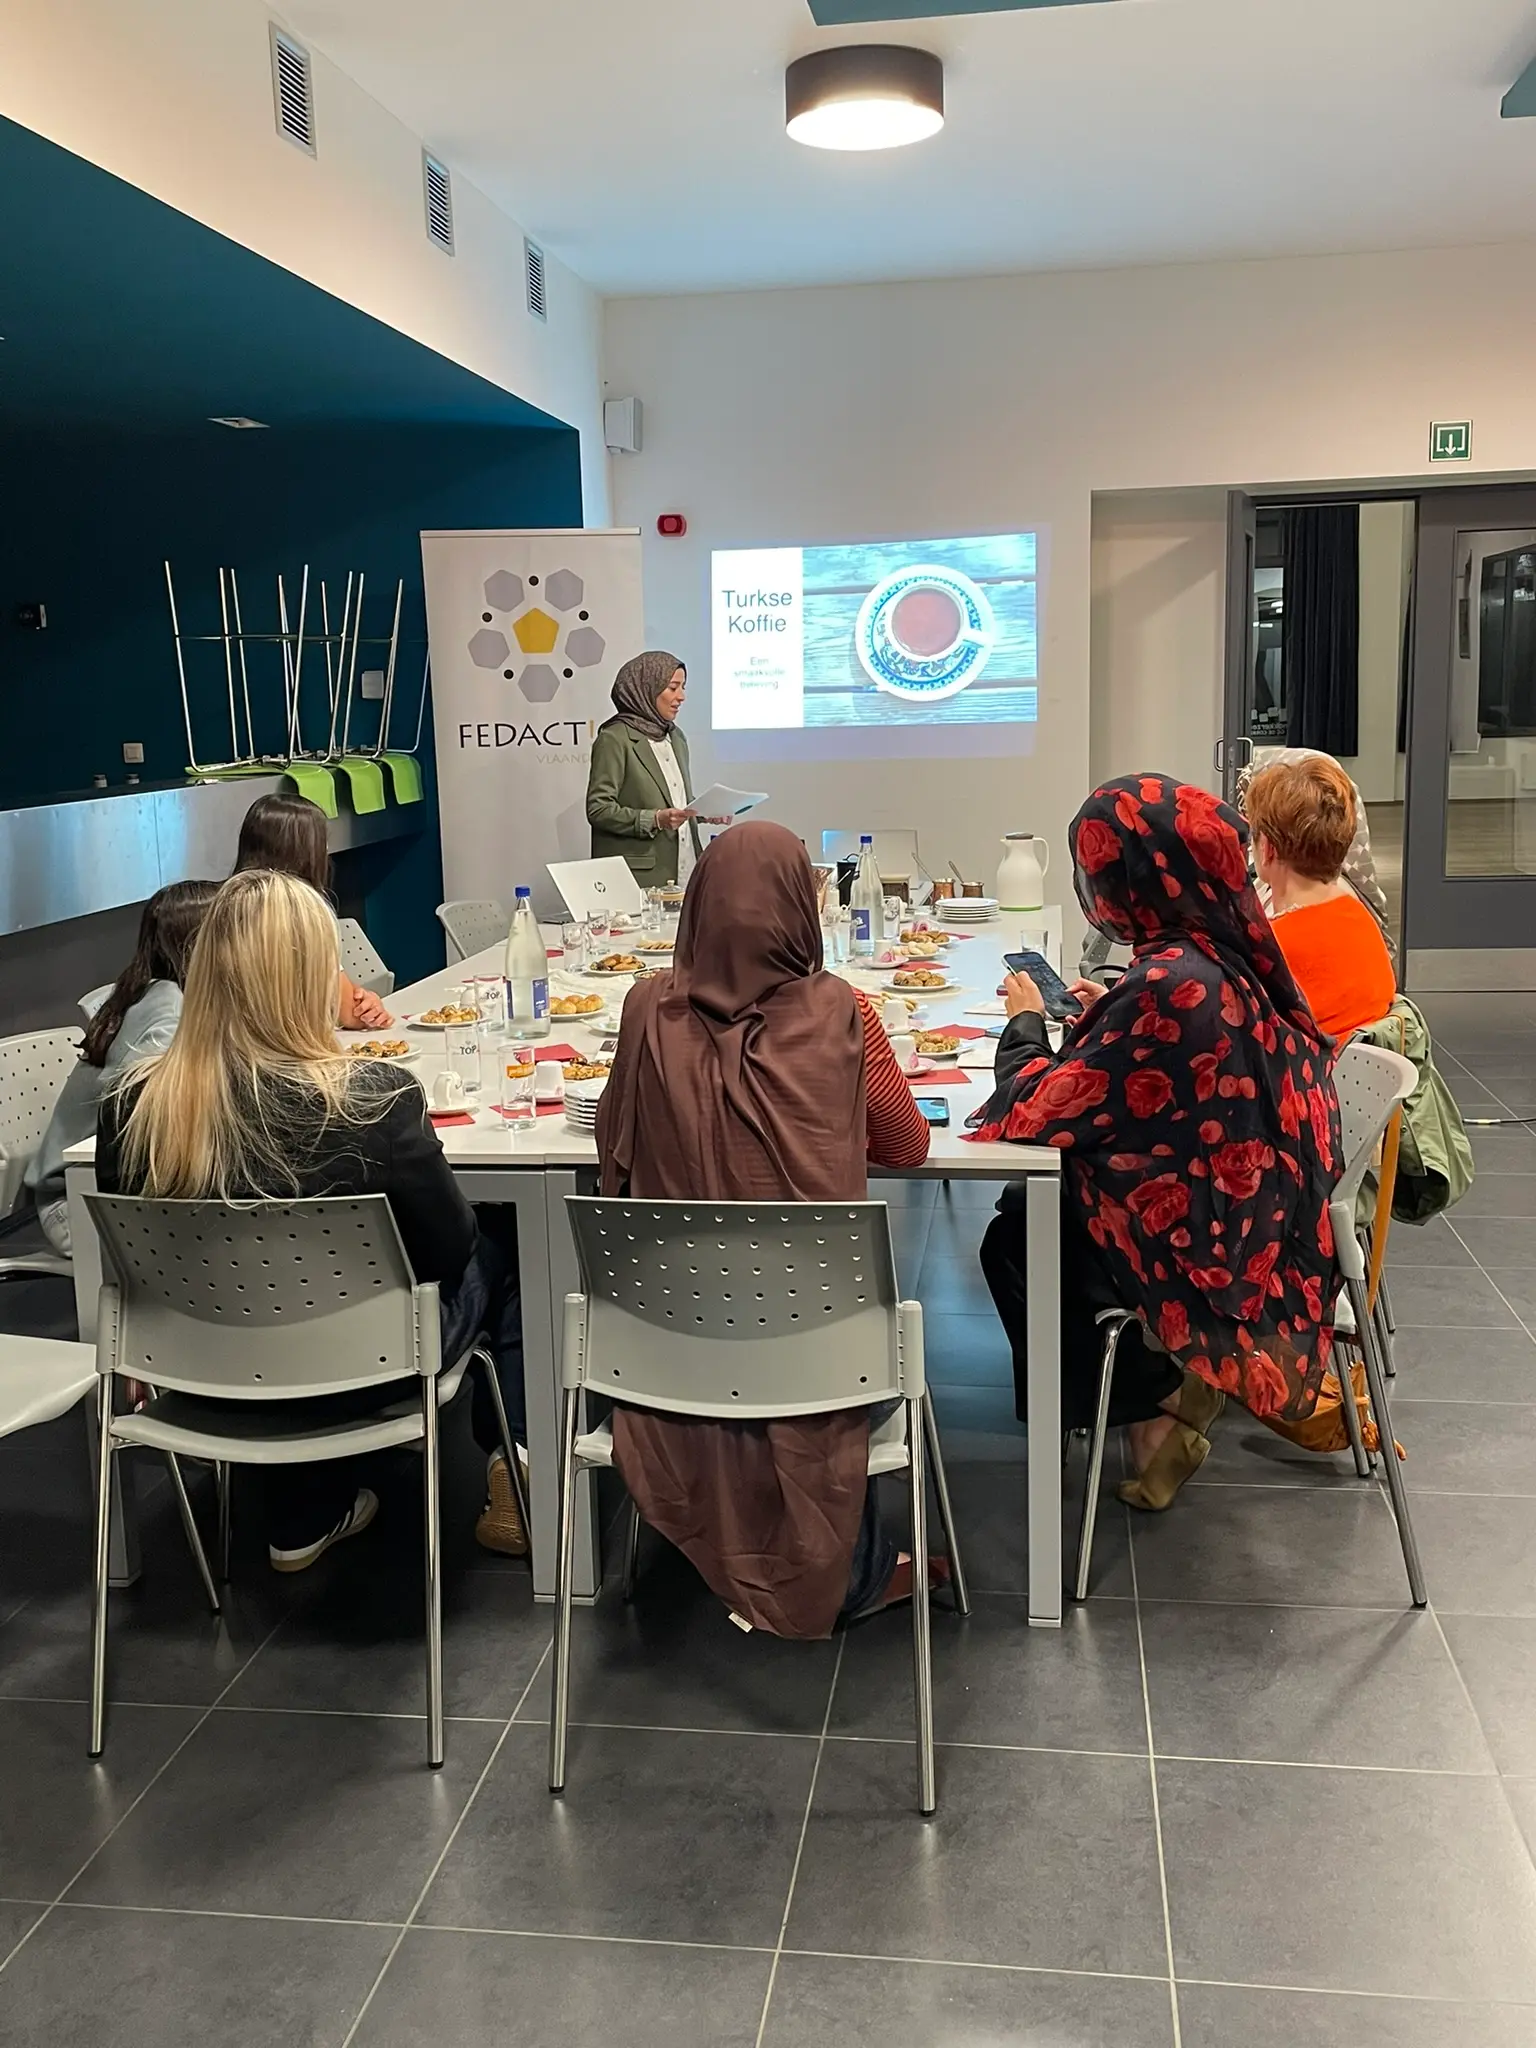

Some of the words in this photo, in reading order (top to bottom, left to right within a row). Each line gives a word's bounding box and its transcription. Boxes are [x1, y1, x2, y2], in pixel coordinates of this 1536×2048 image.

[721, 589, 793, 608] Turkse
[728, 614, 787, 633] Koffie
[459, 720, 594, 748] FEDACTI
[536, 753, 590, 764] VLAAND
[485, 991, 501, 1000] TOP
[459, 1044, 477, 1055] TOP
